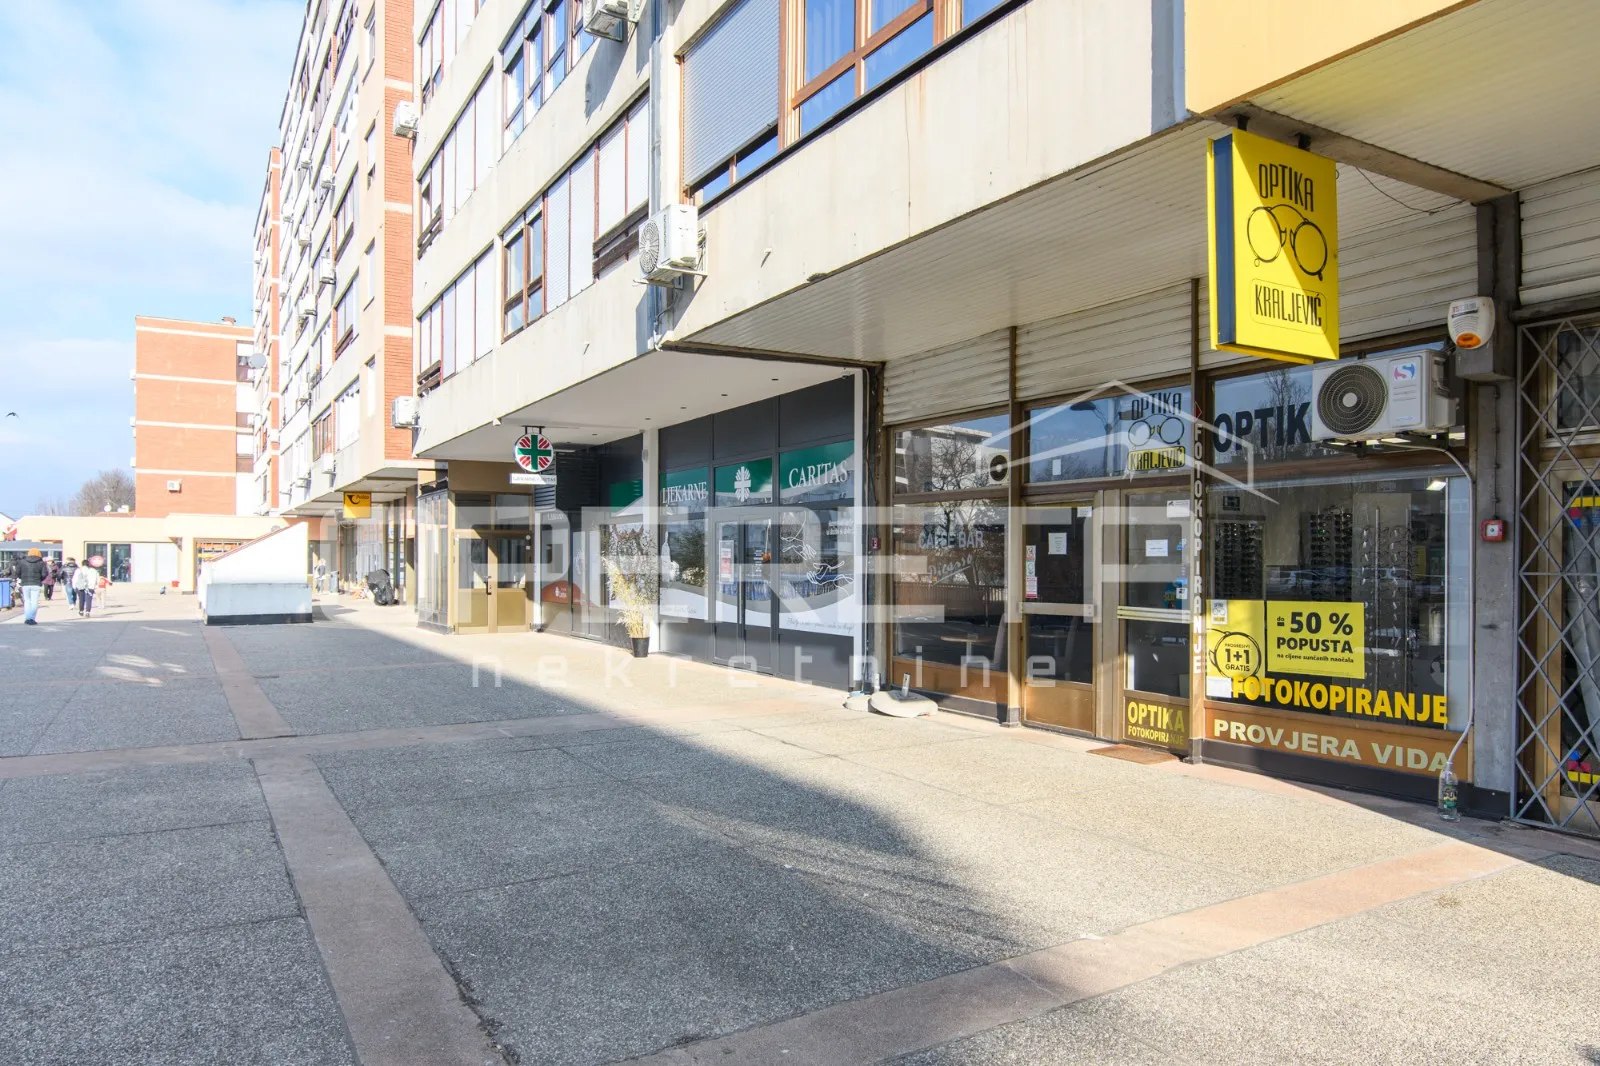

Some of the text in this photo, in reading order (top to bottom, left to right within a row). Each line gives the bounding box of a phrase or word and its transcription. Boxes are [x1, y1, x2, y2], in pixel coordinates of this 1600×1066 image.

[1258, 163, 1314, 212] OPTIKA
[1255, 284, 1322, 327] KRALJEVIĆ
[1131, 392, 1182, 420] OPTIKA
[1130, 446, 1183, 470] KRALJEVIĆ
[788, 461, 848, 489] CARITAS
[662, 482, 708, 504] LJEKARNE
[958, 530, 984, 549] BAR
[1193, 423, 1203, 674] FOTOKOPIRANJE
[1329, 613, 1353, 635] %
[1225, 649, 1250, 664] 1+1
[1277, 637, 1353, 653] POPUSTA
[1232, 677, 1448, 725] FOTOKOPIRANJE
[1128, 702, 1185, 732] OPTIKA
[1128, 726, 1184, 745] FOTOKOPIRANJE
[1214, 719, 1450, 772] PROVJERA VIDA
